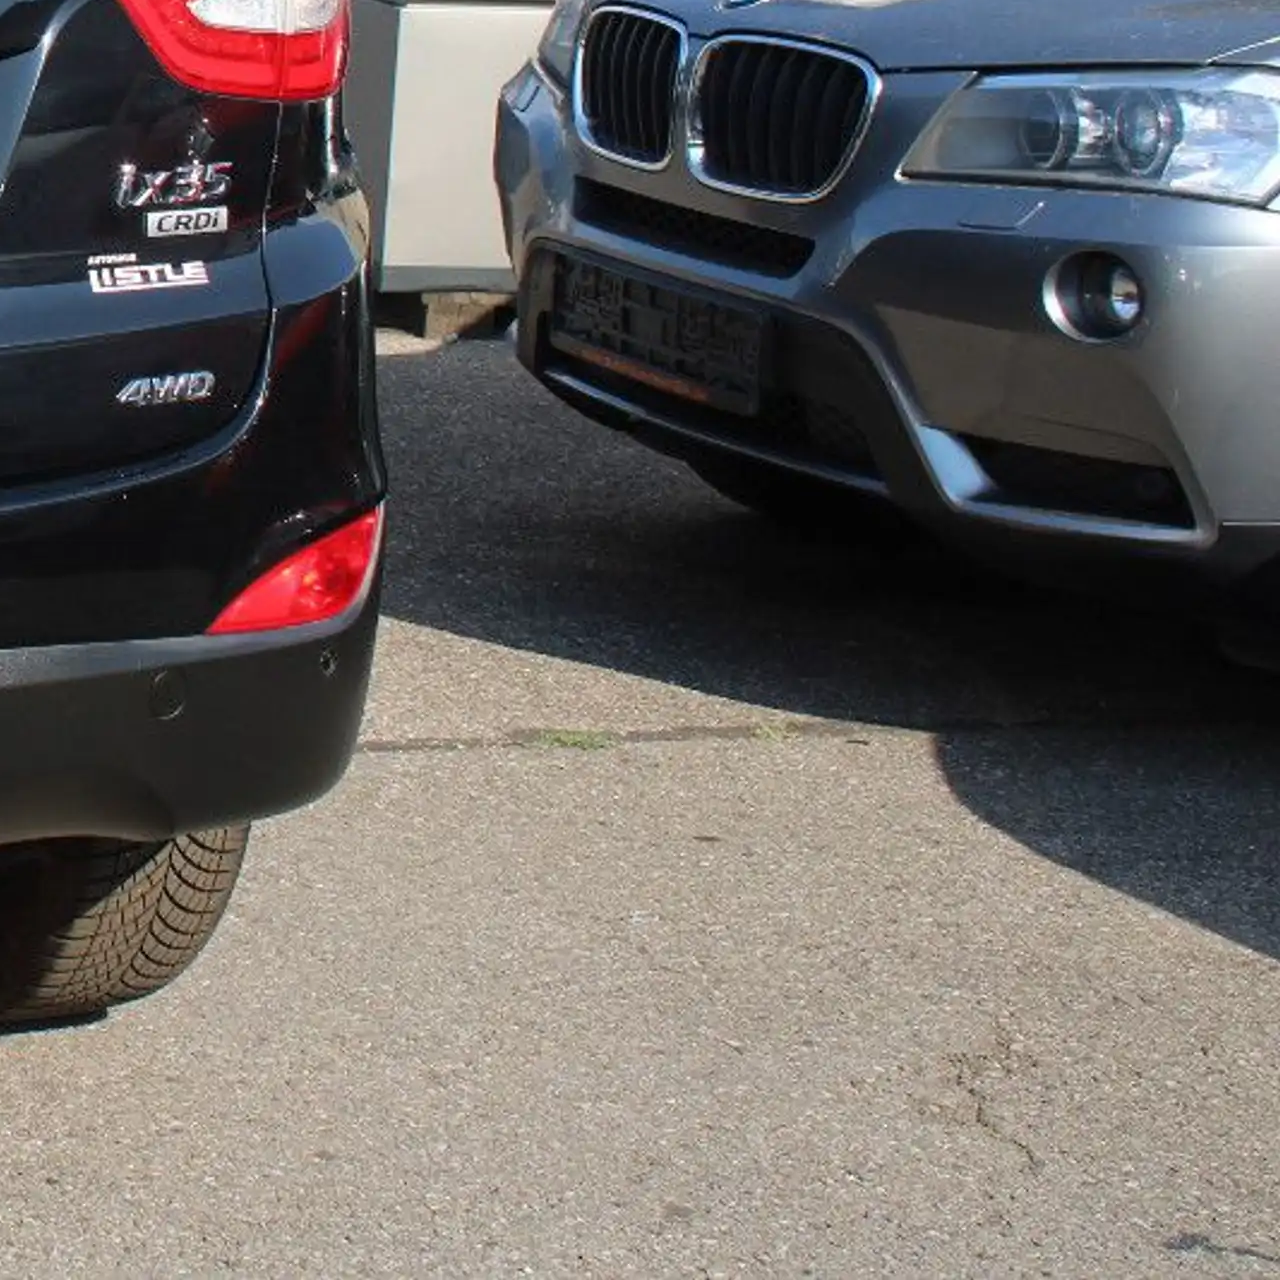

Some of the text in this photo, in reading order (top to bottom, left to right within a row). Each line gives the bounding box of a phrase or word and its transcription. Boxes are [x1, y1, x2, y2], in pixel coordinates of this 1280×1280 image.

[115, 162, 233, 209] ix35
[156, 210, 220, 234] CRDi
[115, 370, 216, 408] 4WD
